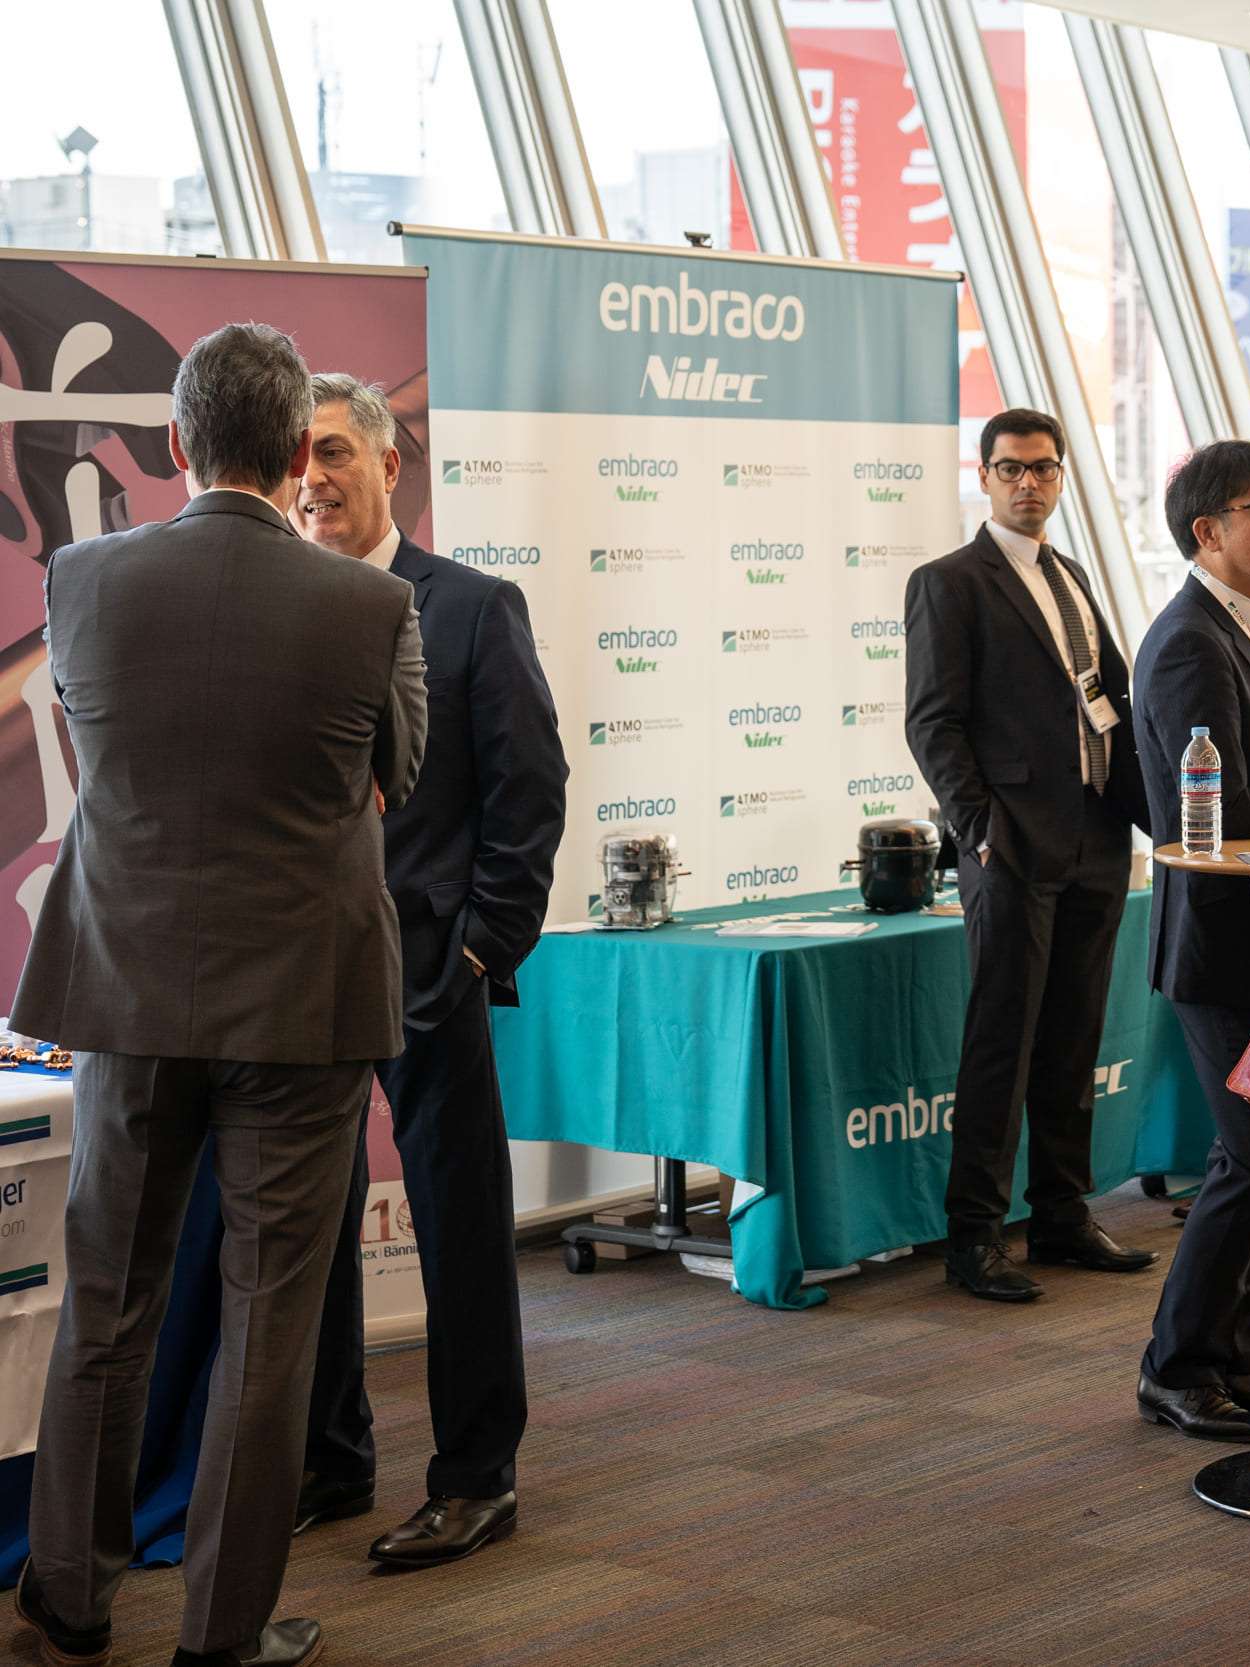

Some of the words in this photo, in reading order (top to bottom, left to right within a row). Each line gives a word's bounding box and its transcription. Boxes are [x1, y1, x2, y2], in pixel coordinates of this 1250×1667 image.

[600, 272, 804, 342] embraco
[640, 355, 768, 403] Nidec
[598, 453, 678, 477] embraco
[853, 458, 923, 480] embraco
[452, 541, 541, 565] embraco
[730, 538, 805, 561] embraco
[598, 625, 677, 650] embraco
[729, 702, 801, 726] embraco
[848, 772, 914, 796] embraco
[597, 795, 676, 822] embraco
[726, 864, 799, 890] embraco
